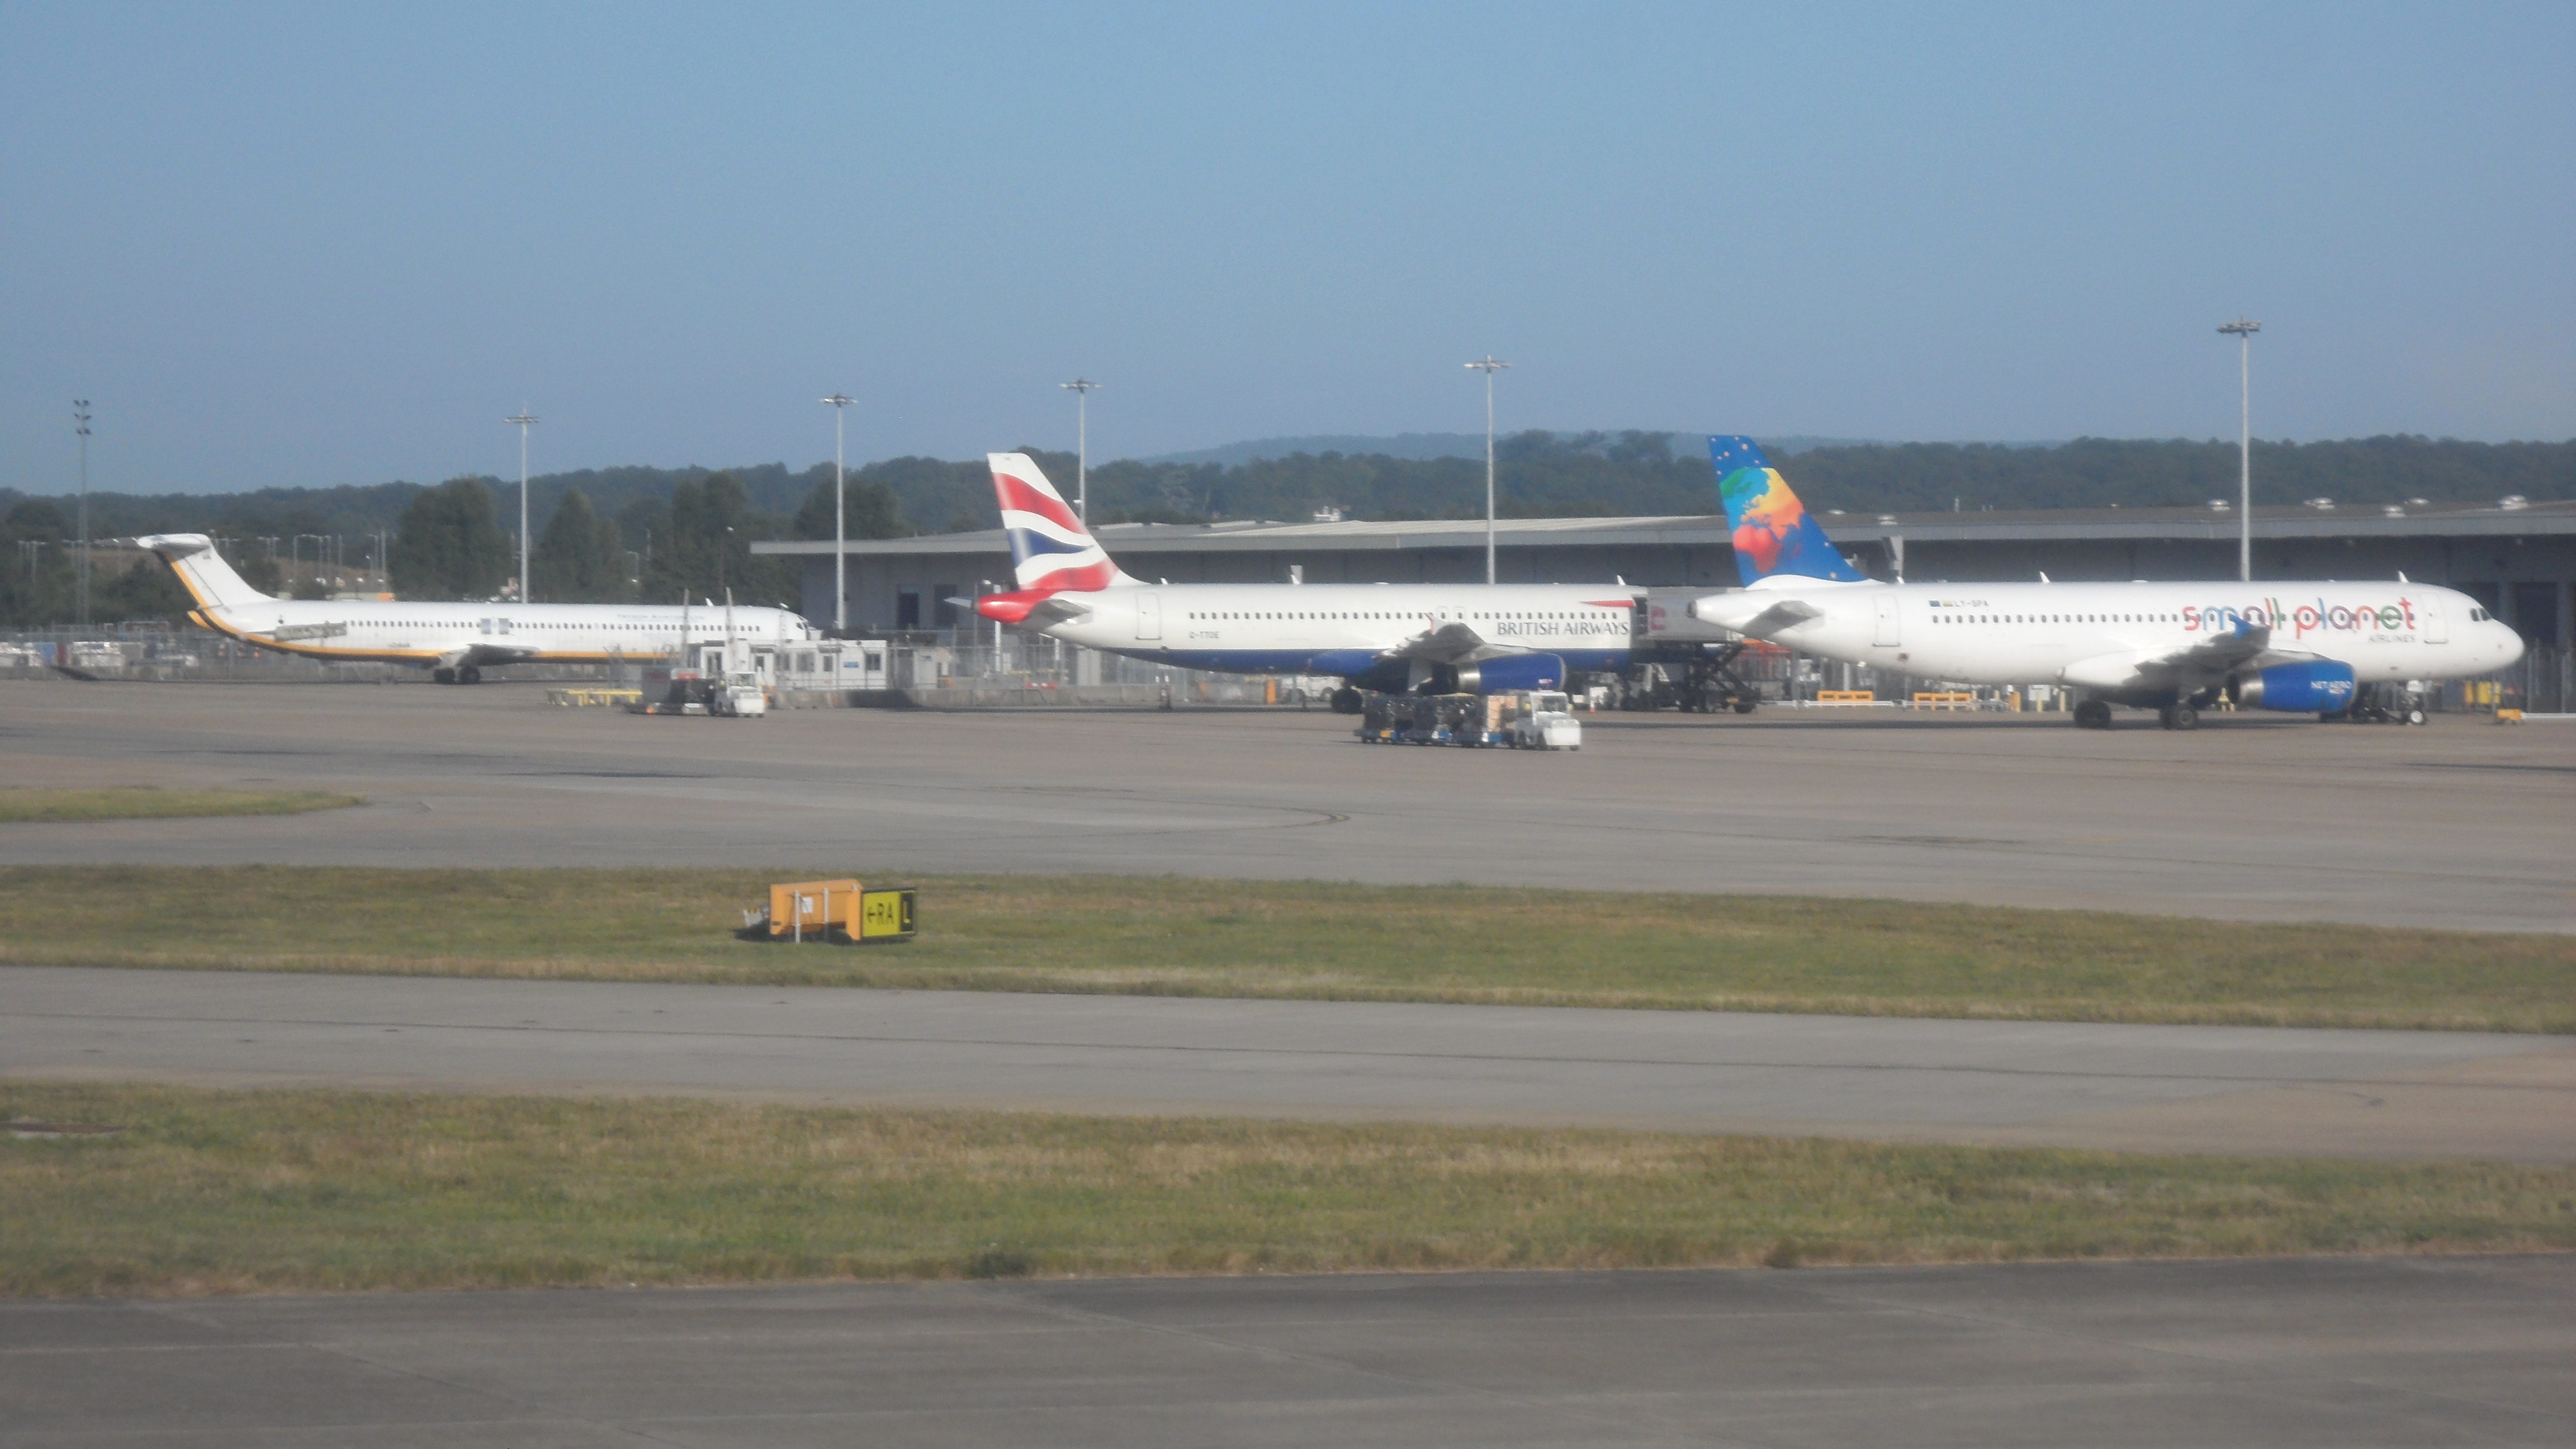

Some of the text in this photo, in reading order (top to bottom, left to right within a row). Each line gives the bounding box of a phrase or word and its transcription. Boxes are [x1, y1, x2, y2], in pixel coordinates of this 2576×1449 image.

[2181, 596, 2416, 640] small planet
[1497, 621, 1630, 636] BRITISH AIRWAYS
[2368, 634, 2416, 643] AIRLINES
